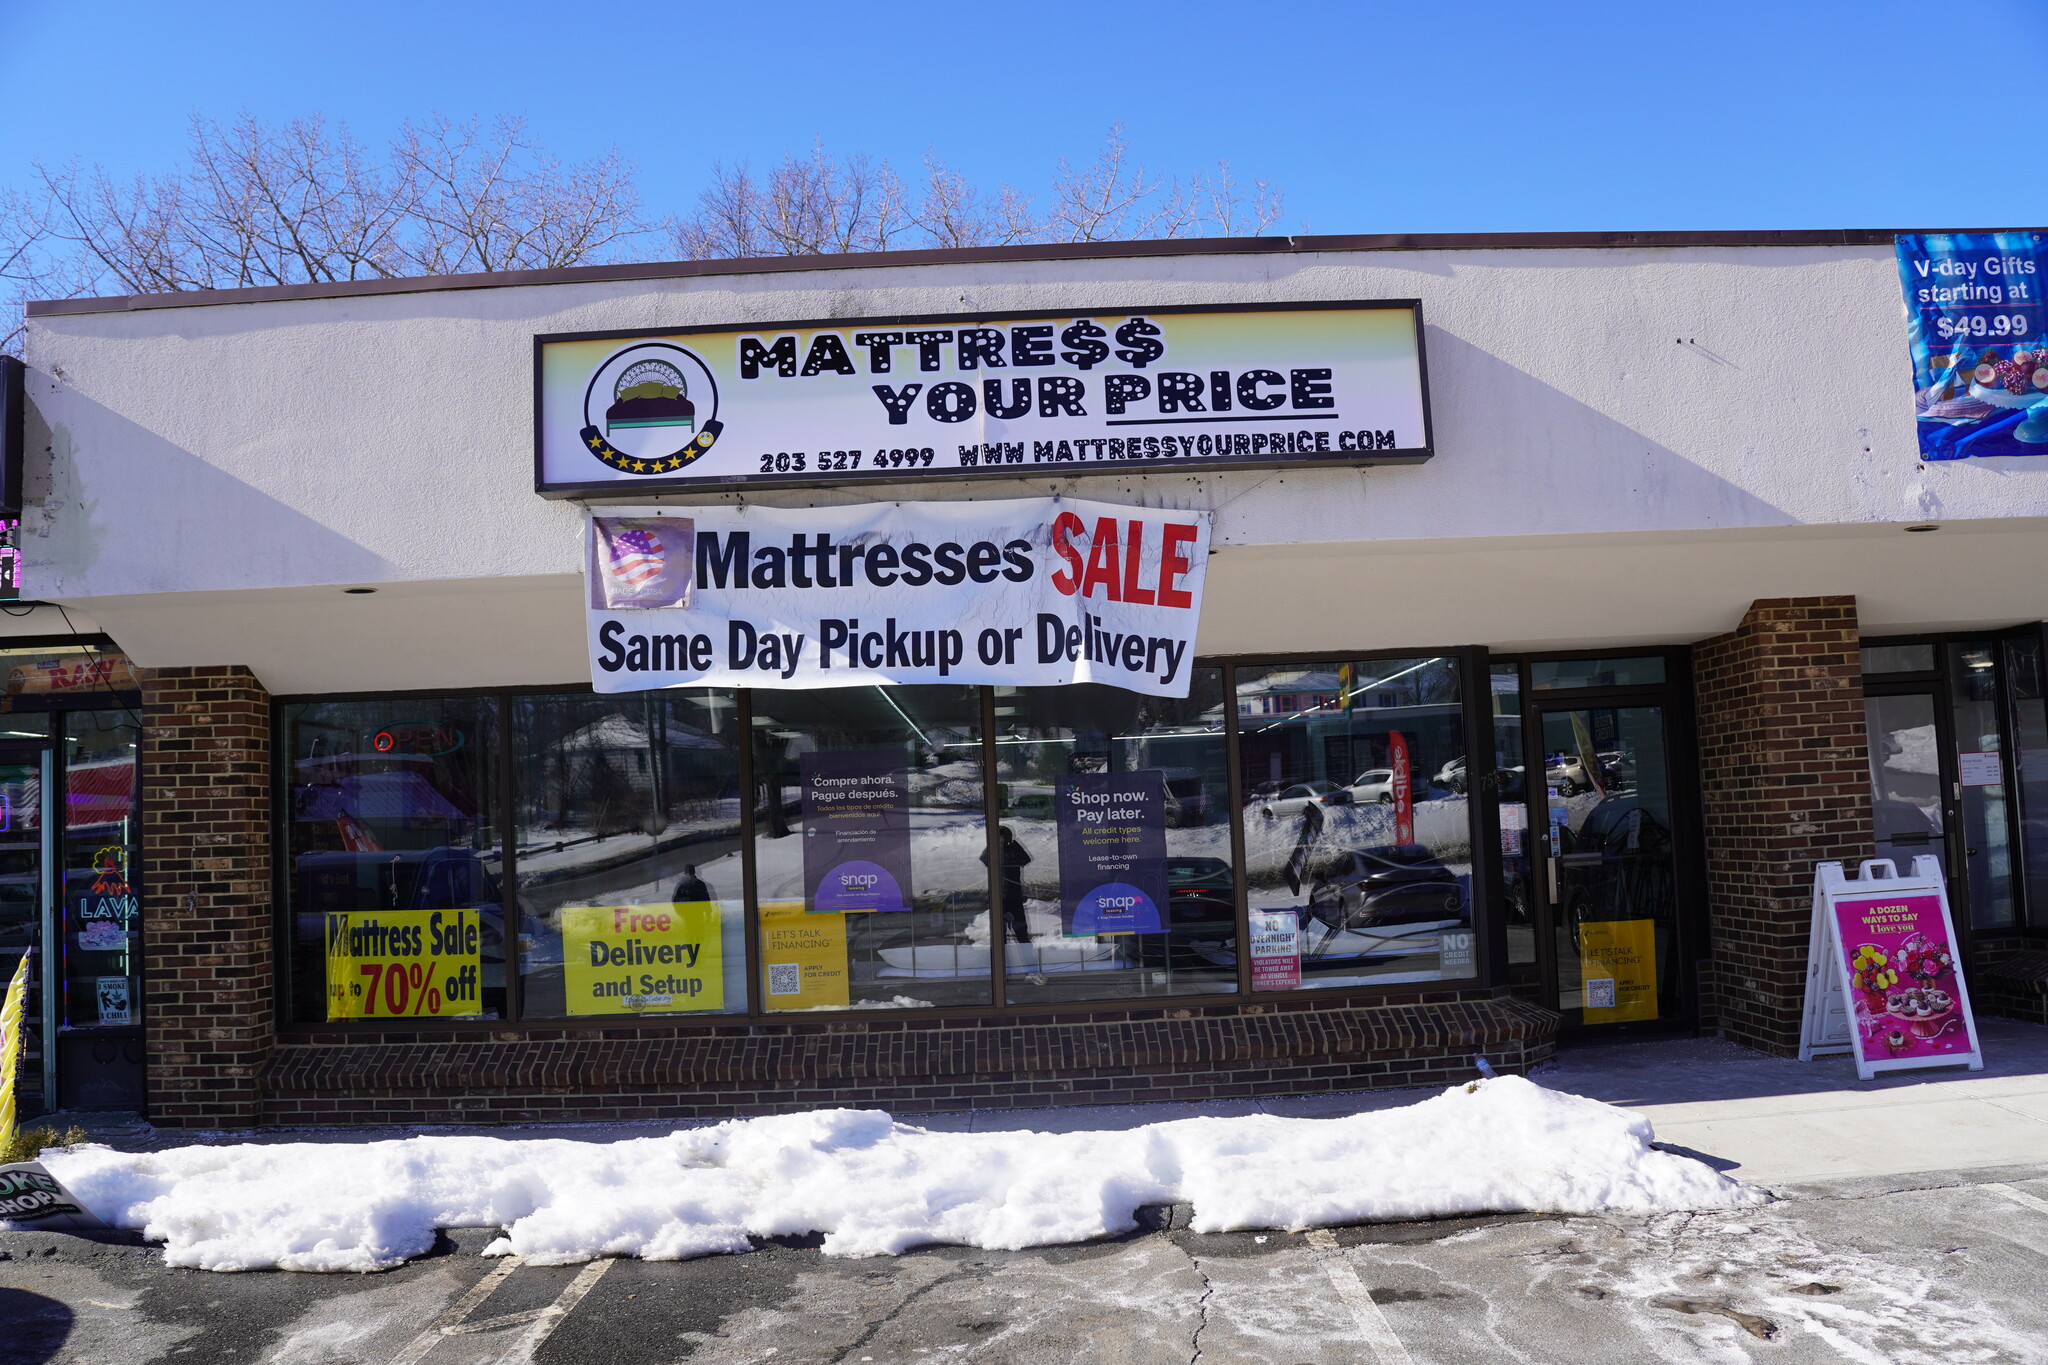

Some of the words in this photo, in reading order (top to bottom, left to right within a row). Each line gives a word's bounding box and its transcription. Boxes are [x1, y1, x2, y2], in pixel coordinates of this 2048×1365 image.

[1914, 258, 1977, 279] V-day
[1984, 257, 2036, 275] Gifts
[1918, 282, 2002, 304] starting
[2008, 281, 2028, 299] at
[1937, 314, 2028, 340] $49.99
[872, 375, 1088, 425] YOUR
[1105, 368, 1335, 415] PRICE
[760, 452, 806, 473] 203
[817, 450, 862, 470] 527
[873, 447, 935, 469] 4999
[958, 441, 1024, 467] WWW
[1033, 431, 1330, 463] MATTRESSYOURPRICE
[1338, 429, 1396, 451] COM
[696, 531, 1035, 590] Mattresses
[1051, 511, 1198, 609] SALE
[597, 619, 713, 674] Same
[728, 619, 804, 680] Day
[819, 617, 963, 676] Pickup
[978, 626, 1023, 665] or
[1037, 612, 1187, 684] Delivery
[48, 659, 116, 690] RAW
[373, 727, 455, 752] OPEN
[814, 777, 858, 788] Compre
[860, 775, 895, 785] ahora.
[811, 791, 846, 803] Pague
[848, 788, 899, 801] después.
[1071, 792, 1110, 807] Shop
[1113, 791, 1149, 803] now.
[1077, 809, 1104, 824] Pay
[1107, 807, 1145, 820] later.
[1082, 827, 1093, 835] All
[1093, 826, 1117, 834] credit
[1118, 826, 1141, 835] types
[1083, 837, 1119, 845] welcome
[1088, 854, 1138, 862] Lease-to-own
[1097, 862, 1130, 870] financing
[841, 873, 878, 888] snap
[80, 896, 139, 919] LAVA
[1098, 896, 1135, 910] snap
[1869, 907, 1876, 915] A
[1877, 904, 1909, 914] DOZEN
[613, 907, 671, 933] Free
[1265, 919, 1279, 932] NO
[1861, 915, 1888, 924] WAYS
[1888, 914, 1900, 922] TO
[1901, 912, 1918, 922] SAY
[329, 913, 422, 957] Mattress
[430, 911, 478, 956] Sale
[771, 929, 797, 940] LET'S
[798, 928, 821, 938] TALK
[1877, 924, 1896, 933] love
[1897, 924, 1915, 934] you
[1250, 932, 1296, 944] OVERNIGHT
[1443, 933, 1469, 951] NO
[590, 940, 701, 968] Delivery
[1255, 944, 1292, 955] PARKING
[1444, 950, 1470, 959] CREDIT
[1590, 947, 1613, 957] LET'S
[1614, 946, 1633, 955] TALK
[1253, 958, 1281, 966] VIOLATORS
[1444, 958, 1470, 966] NEEDED
[350, 980, 362, 997] to
[360, 961, 441, 1016] 70%
[445, 965, 477, 1001] off
[592, 975, 633, 998] and
[639, 973, 703, 998] Setup
[106, 1011, 128, 1019] CHILL
